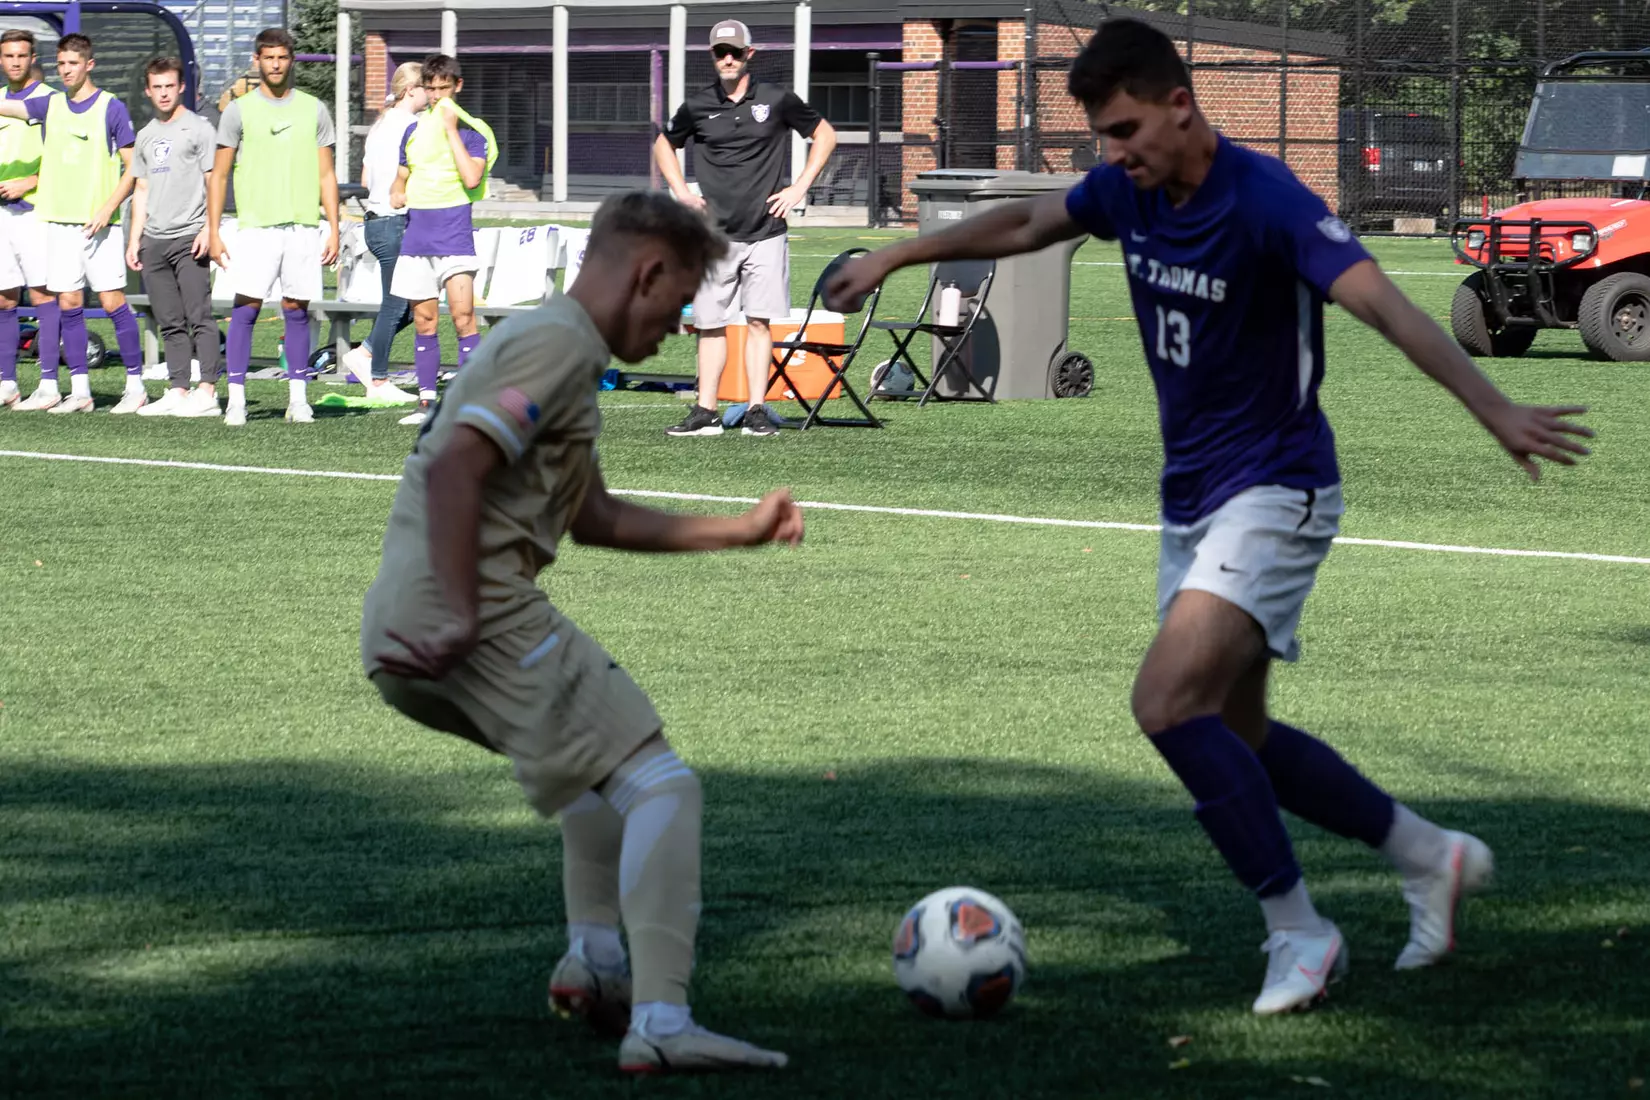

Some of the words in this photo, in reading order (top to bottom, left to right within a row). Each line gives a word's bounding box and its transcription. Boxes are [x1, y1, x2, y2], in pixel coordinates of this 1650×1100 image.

[1127, 253, 1144, 279] T.
[1147, 258, 1228, 303] THOMAS
[1156, 304, 1192, 368] 13
